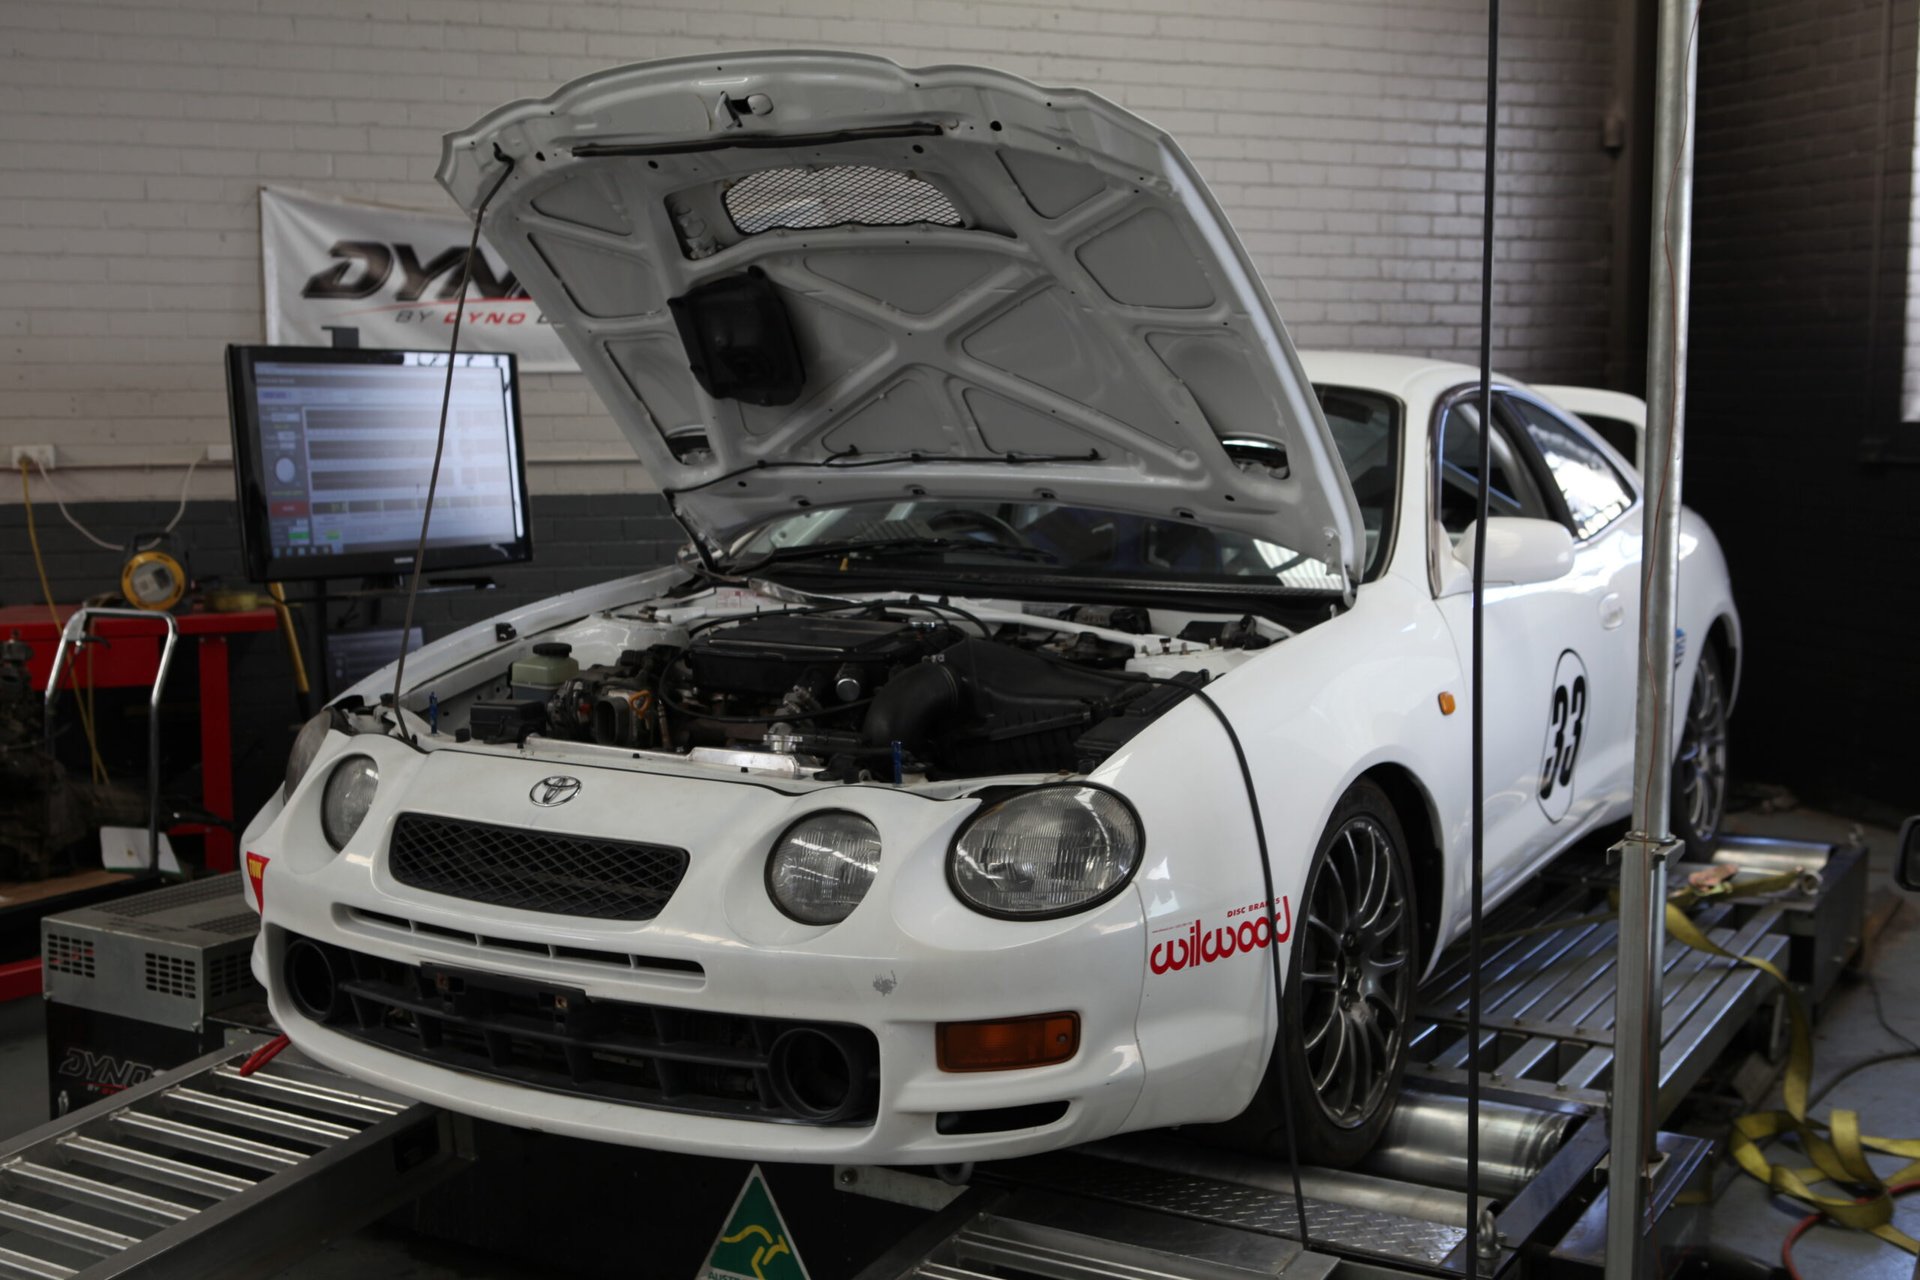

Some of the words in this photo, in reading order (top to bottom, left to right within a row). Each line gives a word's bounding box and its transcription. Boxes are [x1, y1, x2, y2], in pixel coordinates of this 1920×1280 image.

[302, 240, 531, 301] DYN
[396, 311, 433, 323] BY
[443, 312, 526, 325] DYNO
[1540, 675, 1585, 799] 33
[1150, 895, 1291, 975] wilwood
[1227, 907, 1246, 918] DISC
[1249, 897, 1280, 911] BRAKS
